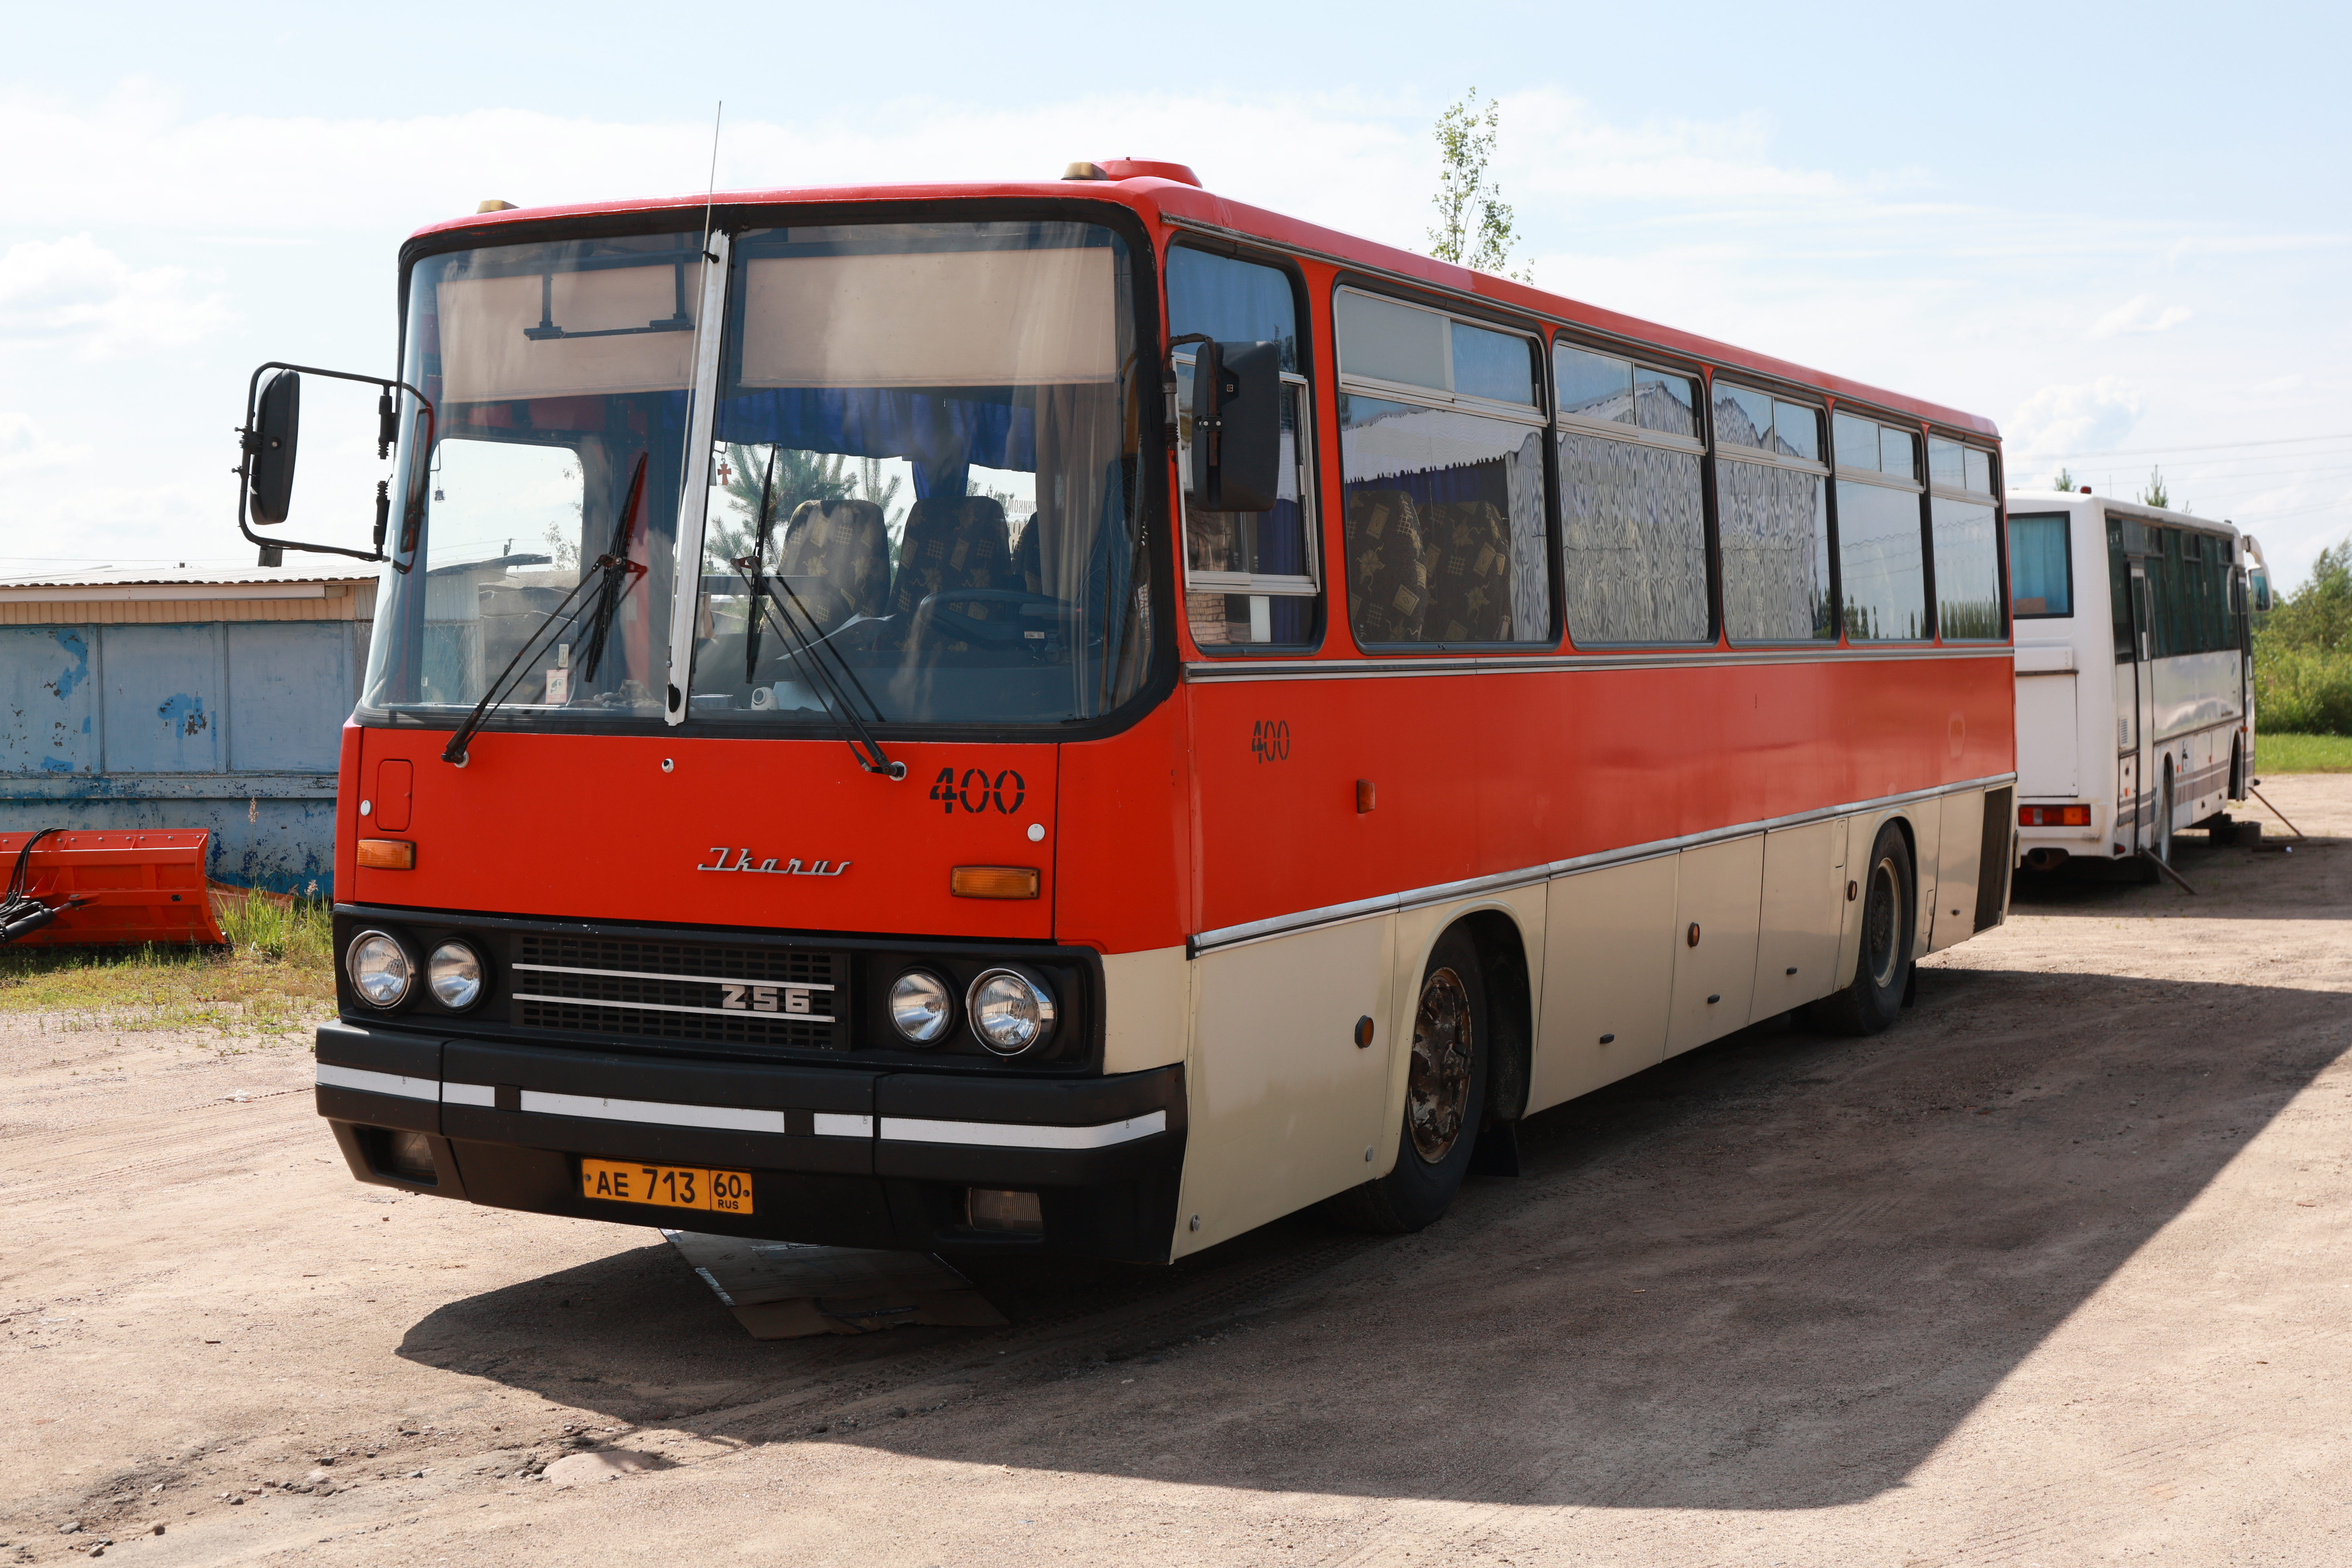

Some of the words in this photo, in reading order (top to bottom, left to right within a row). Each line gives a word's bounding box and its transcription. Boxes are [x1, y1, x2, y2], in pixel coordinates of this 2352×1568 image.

[1251, 720, 1290, 764] 400
[929, 768, 1025, 815] 400
[697, 847, 852, 876] Ikarus
[597, 1171, 628, 1197] AE
[643, 1168, 695, 1203] 713
[714, 1173, 741, 1198] 60
[718, 1200, 739, 1210] RUS
